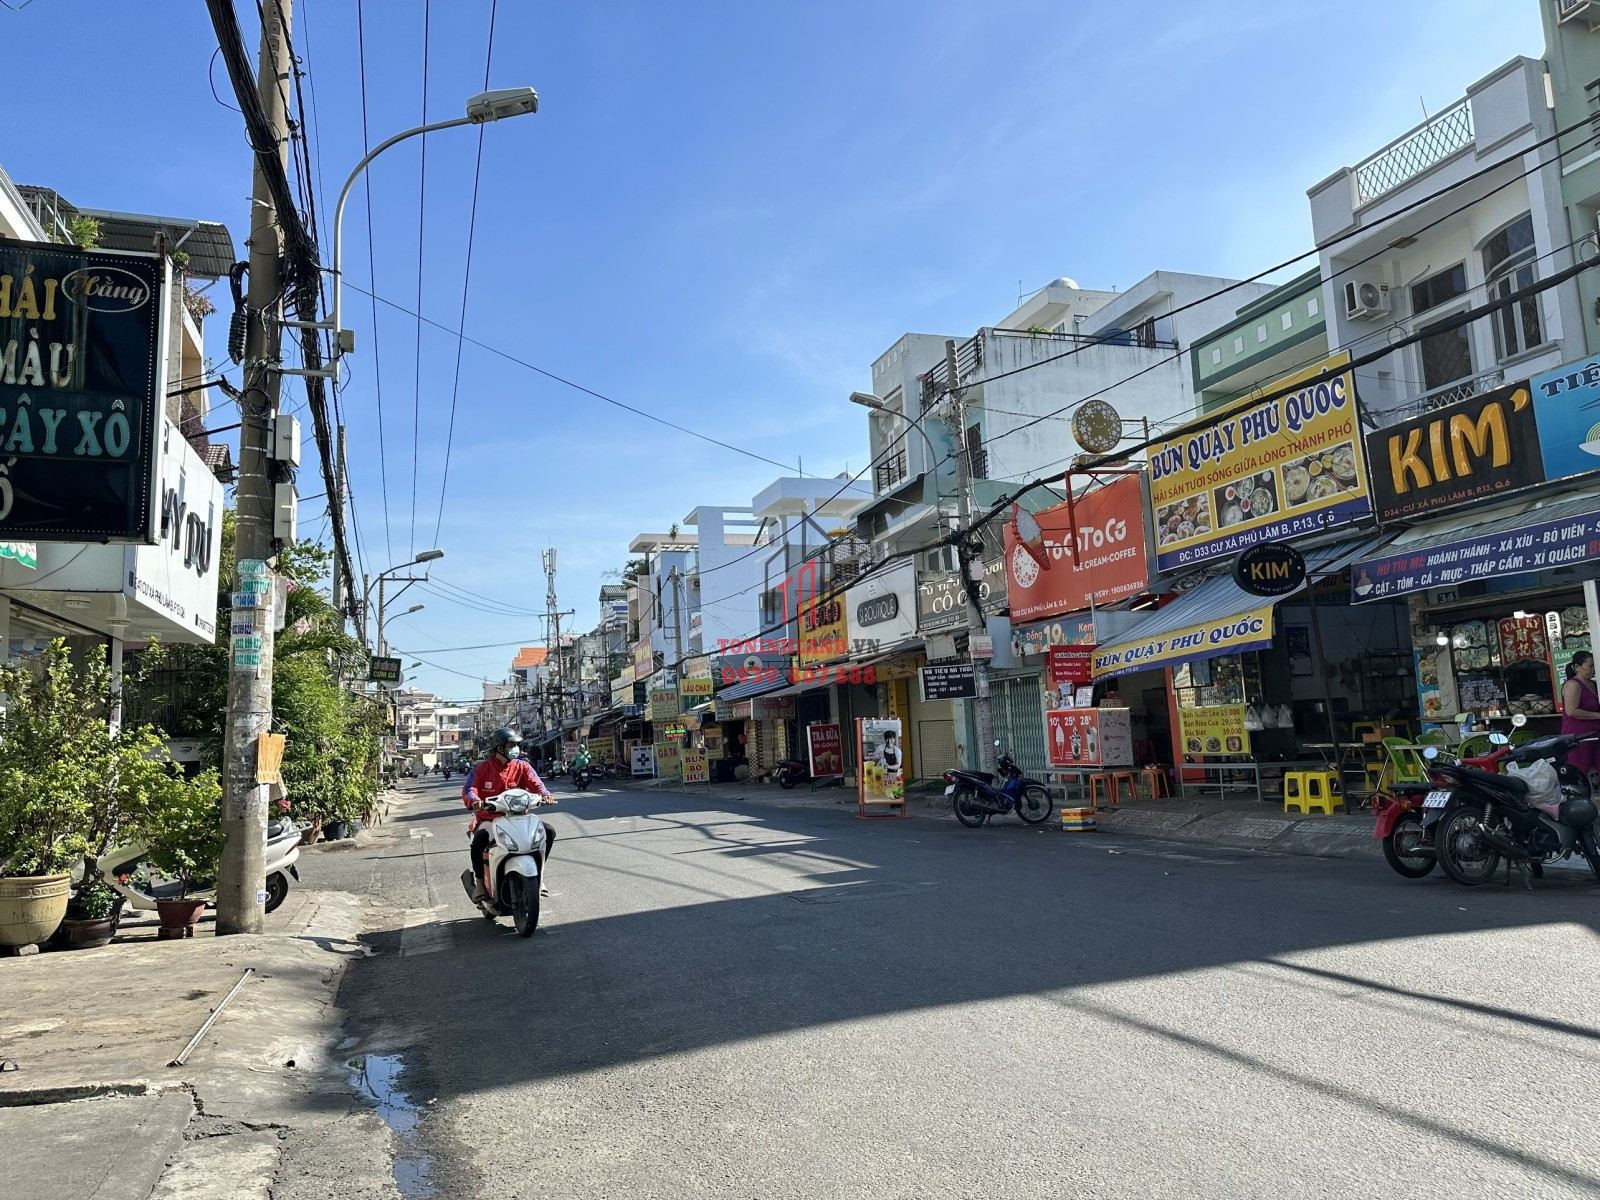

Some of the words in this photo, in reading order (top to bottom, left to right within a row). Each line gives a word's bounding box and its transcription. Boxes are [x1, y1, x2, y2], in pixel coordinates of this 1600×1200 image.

[74, 399, 131, 457] XÔ
[1151, 443, 1183, 480] BÚN
[1240, 401, 1280, 445] PHÚ
[1185, 477, 1205, 492] TƯƠI
[1259, 450, 1287, 465] LÒNG
[1287, 432, 1325, 455] THÀNH
[1328, 418, 1352, 440] PHỐ
[1179, 551, 1193, 562] ĐC:
[1195, 546, 1210, 558] D33
[1211, 542, 1223, 554] CƯ
[1225, 538, 1237, 551] XÁ
[1239, 530, 1258, 546] PHÚ
[1259, 526, 1280, 540] LÂM
[1281, 524, 1292, 535] B,
[1293, 518, 1316, 531] P.13,
[1427, 550, 1458, 566] HOÀNH
[1459, 544, 1490, 560] THÁNH
[1498, 537, 1513, 552] XÁ
[1514, 534, 1533, 549] XÍU
[1543, 527, 1558, 543] BÒ
[1561, 523, 1585, 540] VIÊN
[983, 562, 1003, 575] ƯƠI
[1397, 577, 1414, 590] TÔM
[1421, 571, 1432, 585] CÁ
[1440, 567, 1463, 582] MỰC
[1470, 559, 1496, 575] THẬP
[1534, 550, 1546, 565] XÍ
[1548, 544, 1586, 563] QUÁCH
[1078, 622, 1094, 632] Kem
[1095, 652, 1121, 670] BÚN
[1124, 640, 1168, 663] QUẬY
[1170, 629, 1206, 650] PHÚ
[1209, 615, 1263, 644] QUỐC
[1183, 711, 1194, 719] Bún
[1183, 720, 1194, 728] Bún
[811, 728, 825, 741] TRÀ
[685, 753, 705, 764] BÚN
[689, 762, 702, 772] BÒ
